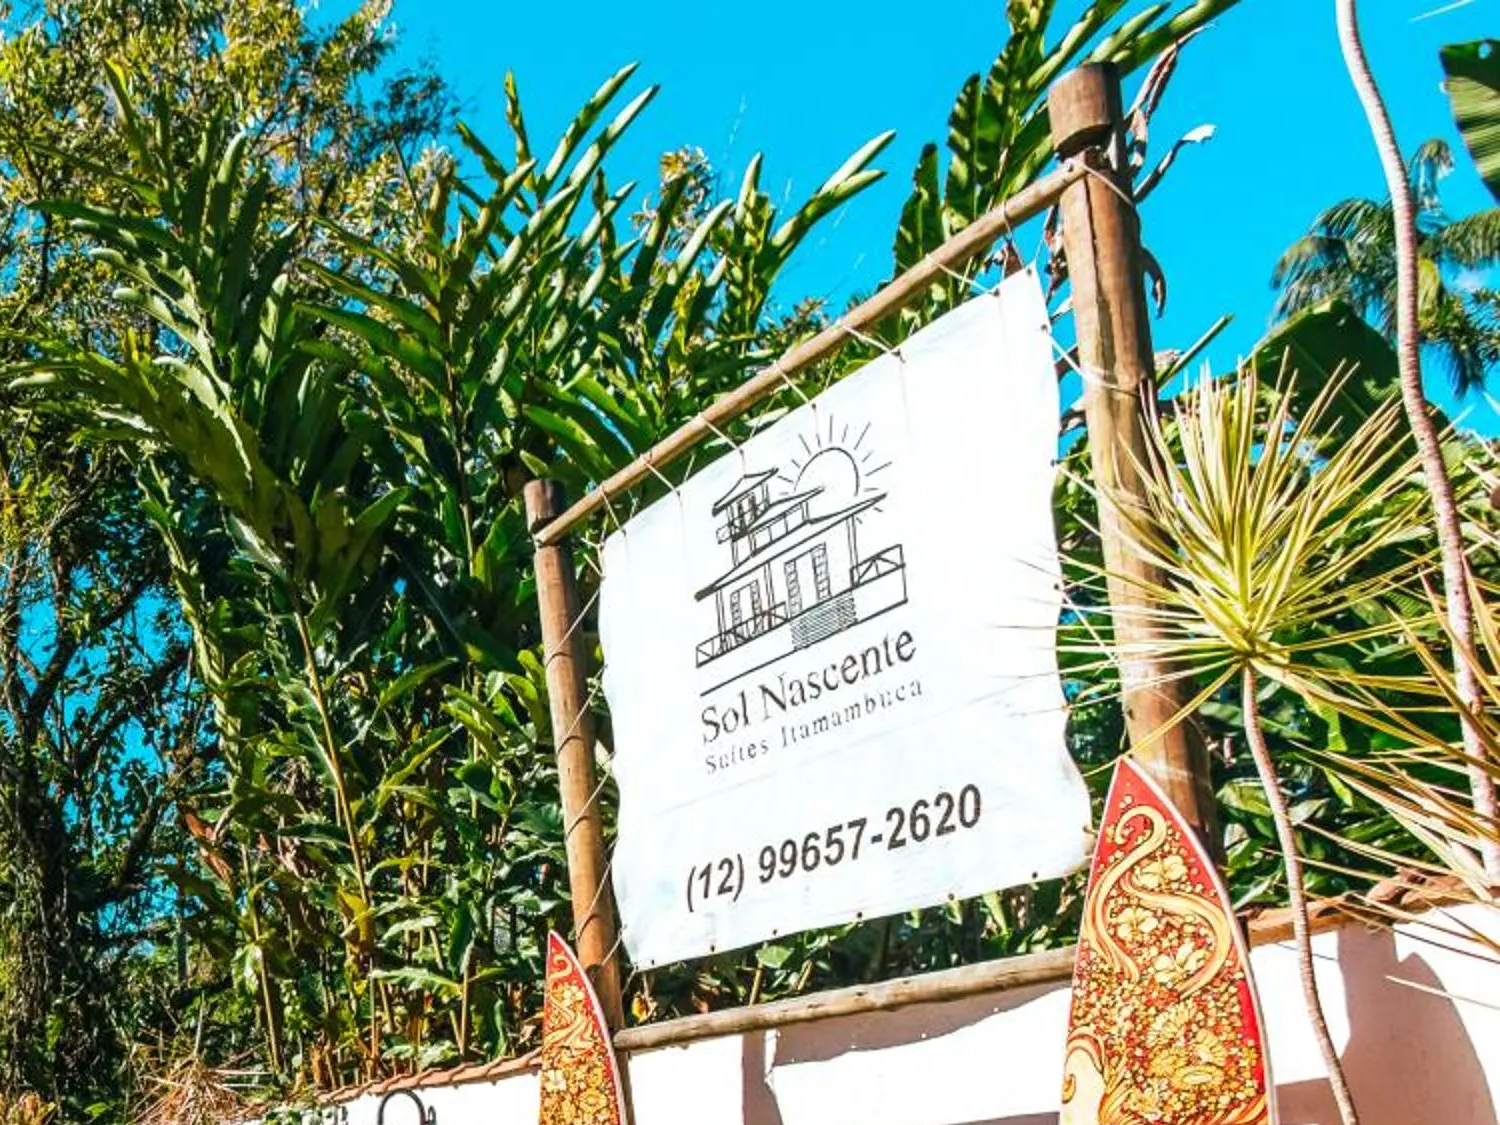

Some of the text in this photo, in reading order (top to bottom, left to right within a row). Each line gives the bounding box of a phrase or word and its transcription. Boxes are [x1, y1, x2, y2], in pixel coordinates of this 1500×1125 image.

[701, 629, 916, 745] Sol Nascente
[686, 783, 982, 913] (12) 99657-2620
